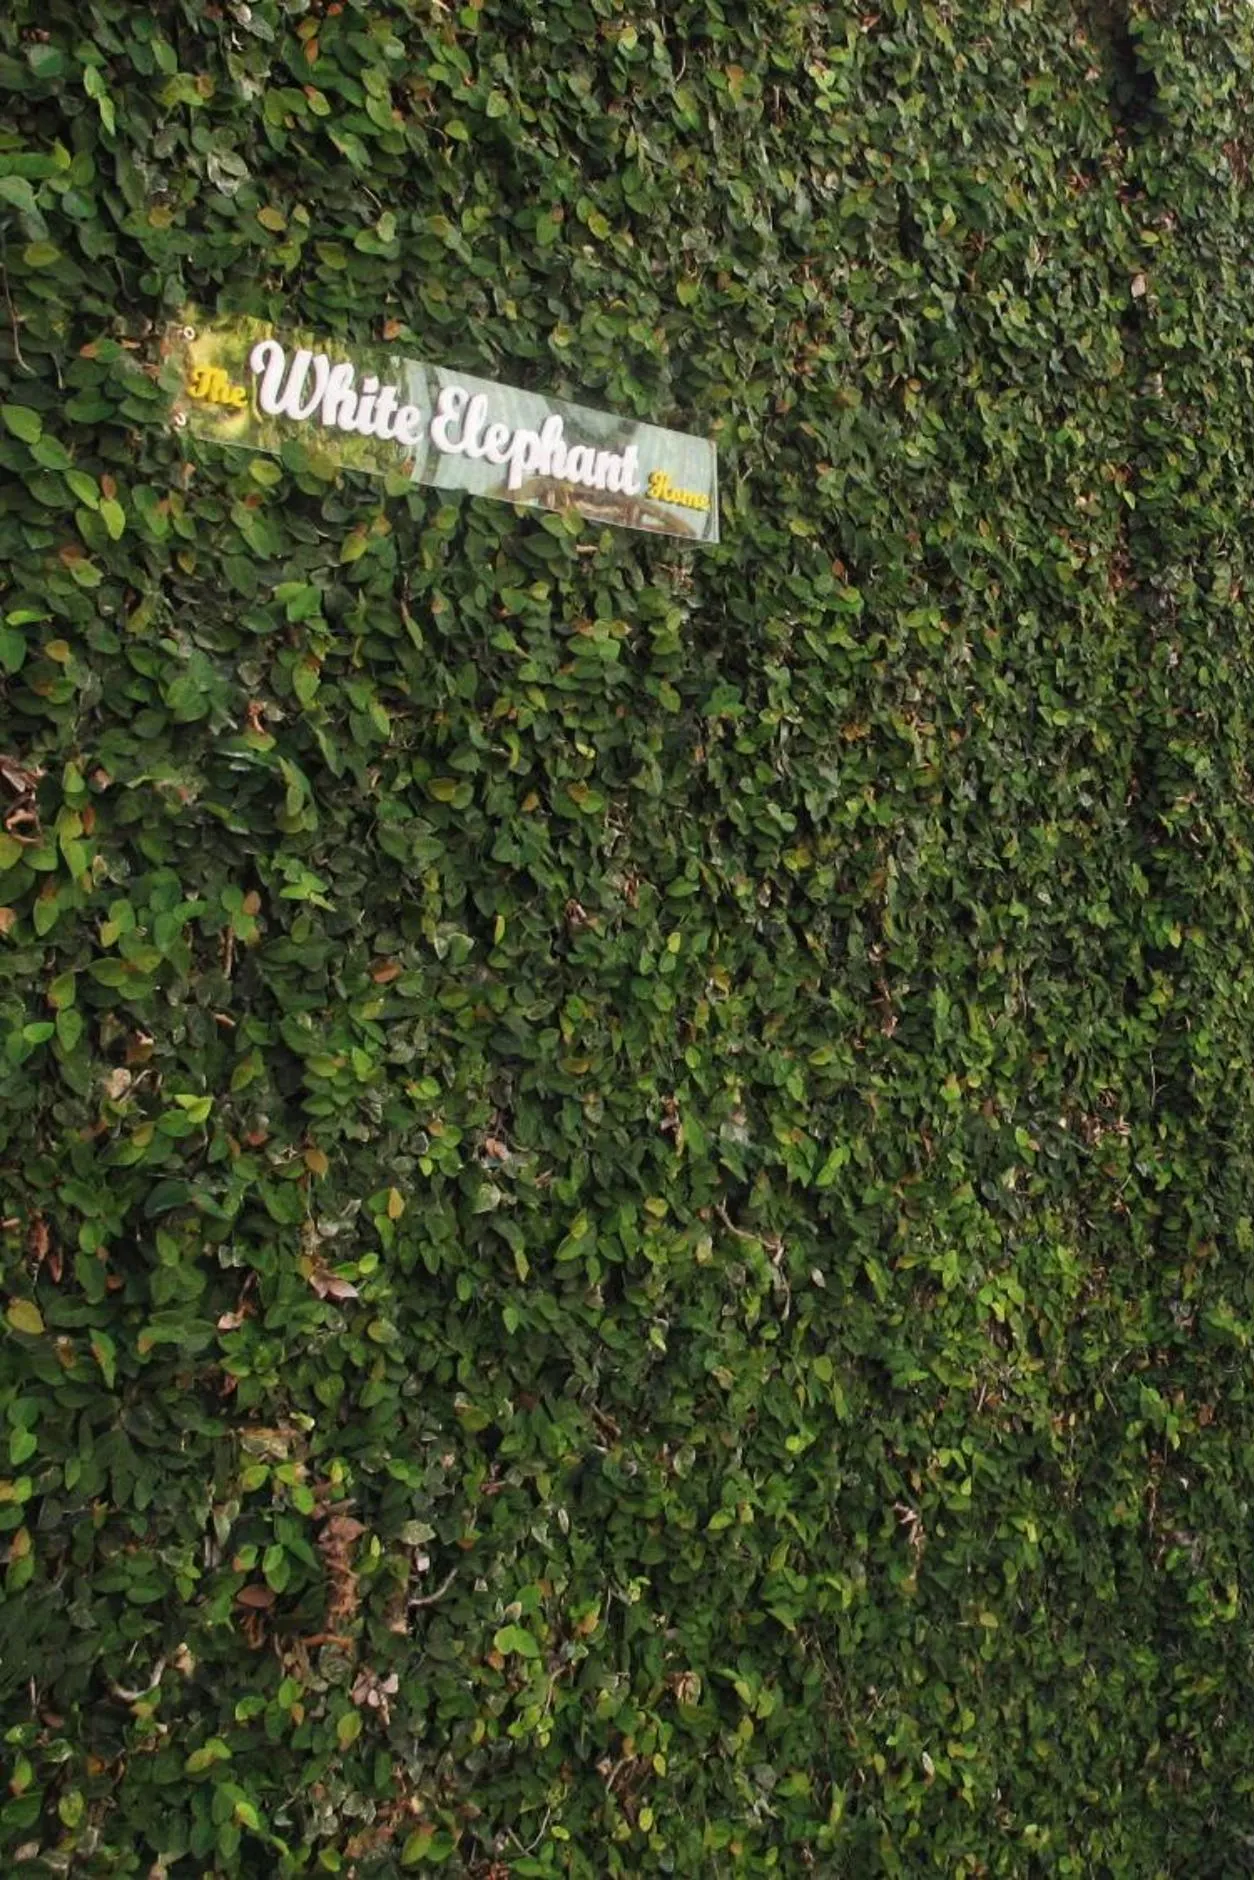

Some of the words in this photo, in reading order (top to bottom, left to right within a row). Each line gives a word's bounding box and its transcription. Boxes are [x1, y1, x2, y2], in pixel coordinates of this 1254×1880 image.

[188, 367, 247, 408] The
[250, 339, 424, 446] White
[431, 385, 640, 496] Elephant
